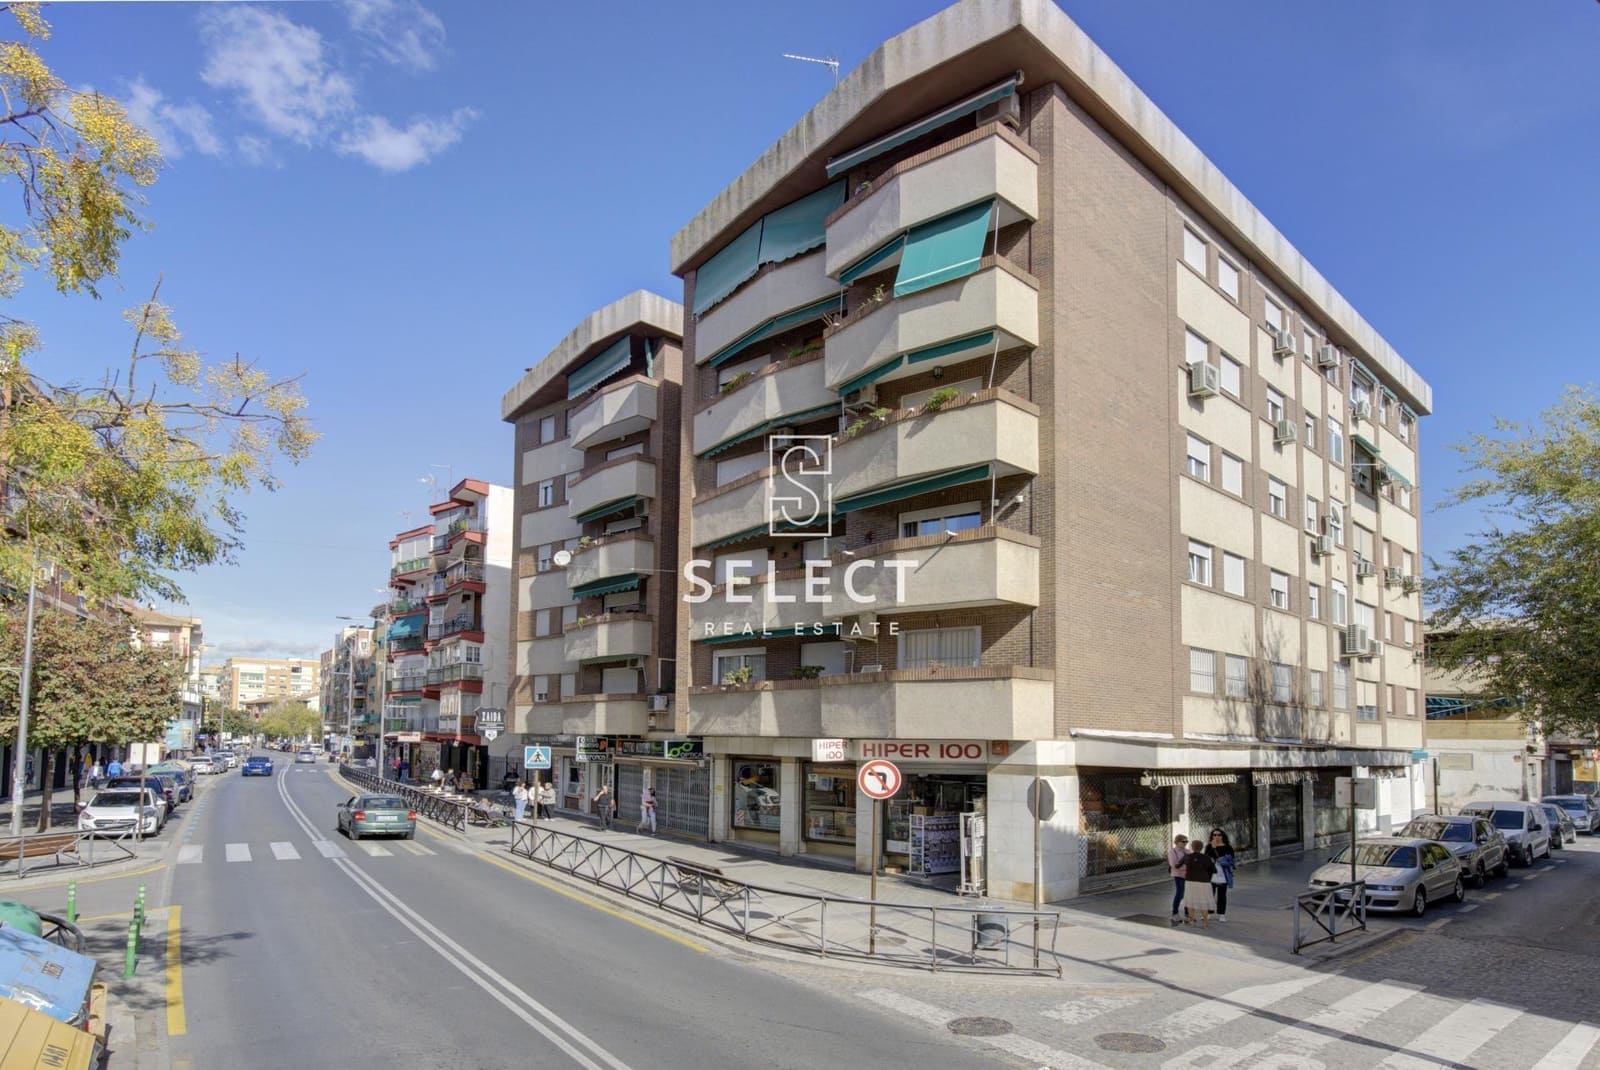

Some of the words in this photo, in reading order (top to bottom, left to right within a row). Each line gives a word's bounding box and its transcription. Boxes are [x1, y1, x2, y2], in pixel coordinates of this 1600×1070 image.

[481, 711, 502, 722] ZAIDA
[818, 741, 848, 750] HIPER
[863, 743, 930, 758] HIPER
